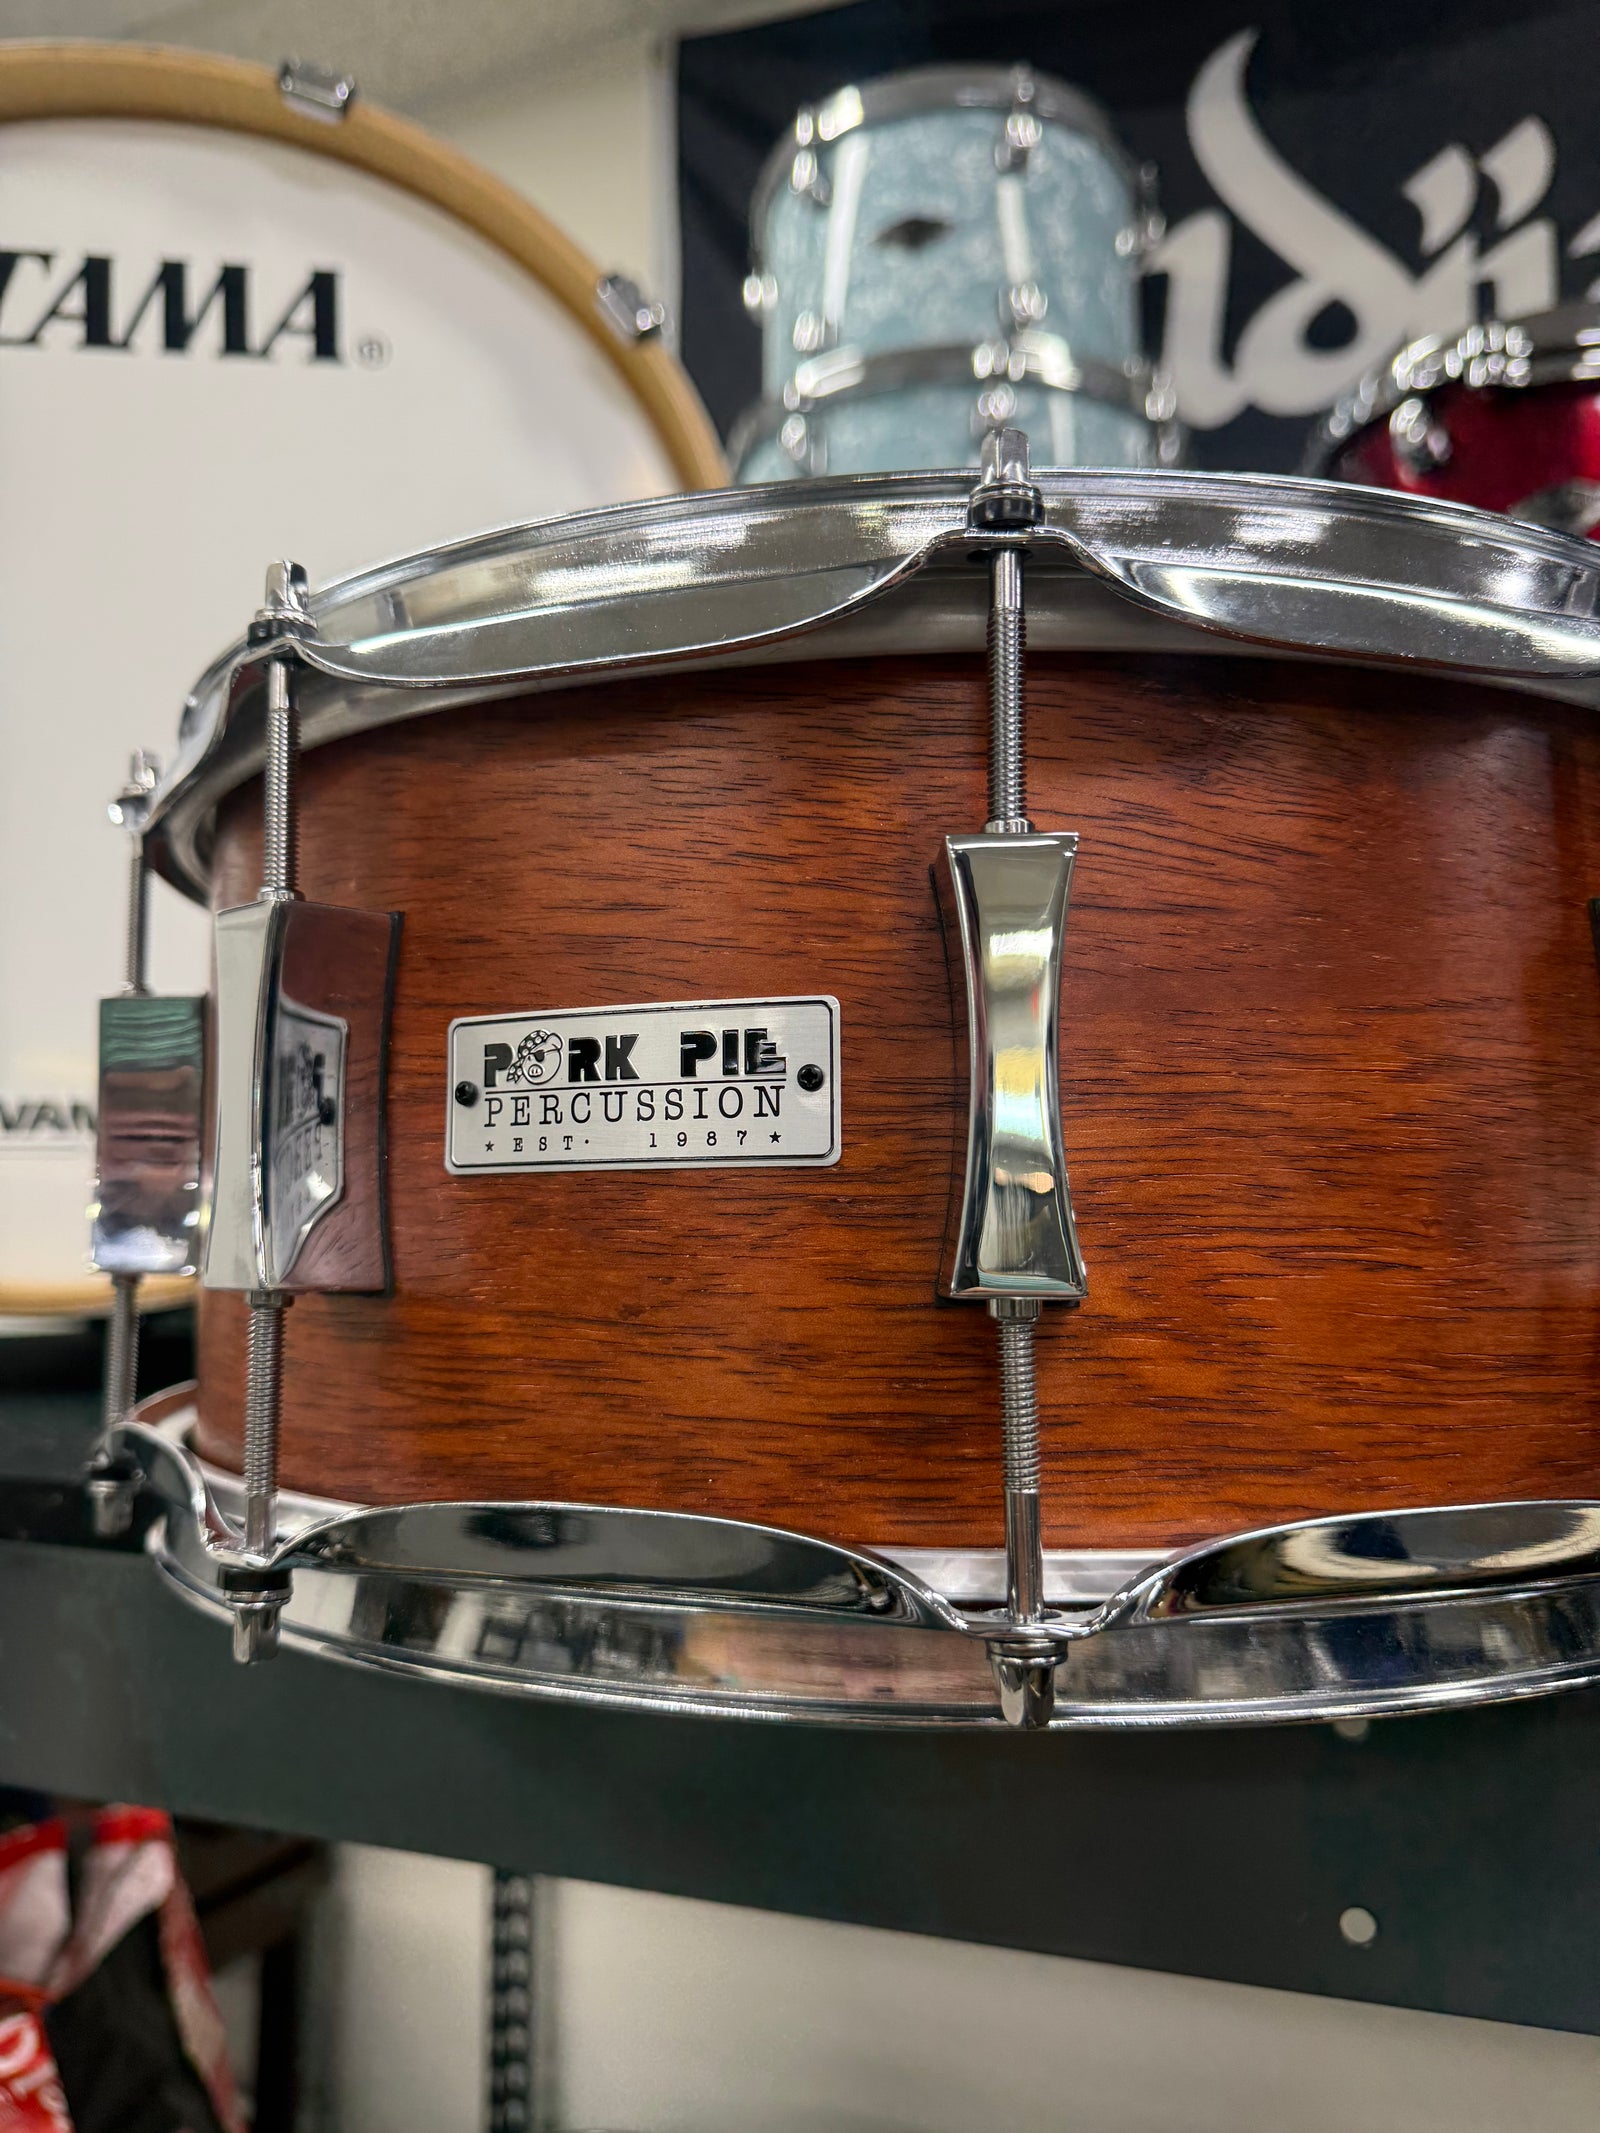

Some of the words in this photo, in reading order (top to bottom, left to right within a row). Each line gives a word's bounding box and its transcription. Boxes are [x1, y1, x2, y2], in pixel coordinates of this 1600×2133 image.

[680, 1027, 787, 1078] PIE
[484, 1085, 786, 1128] PERCUSSION
[648, 1130, 748, 1149] 1987
